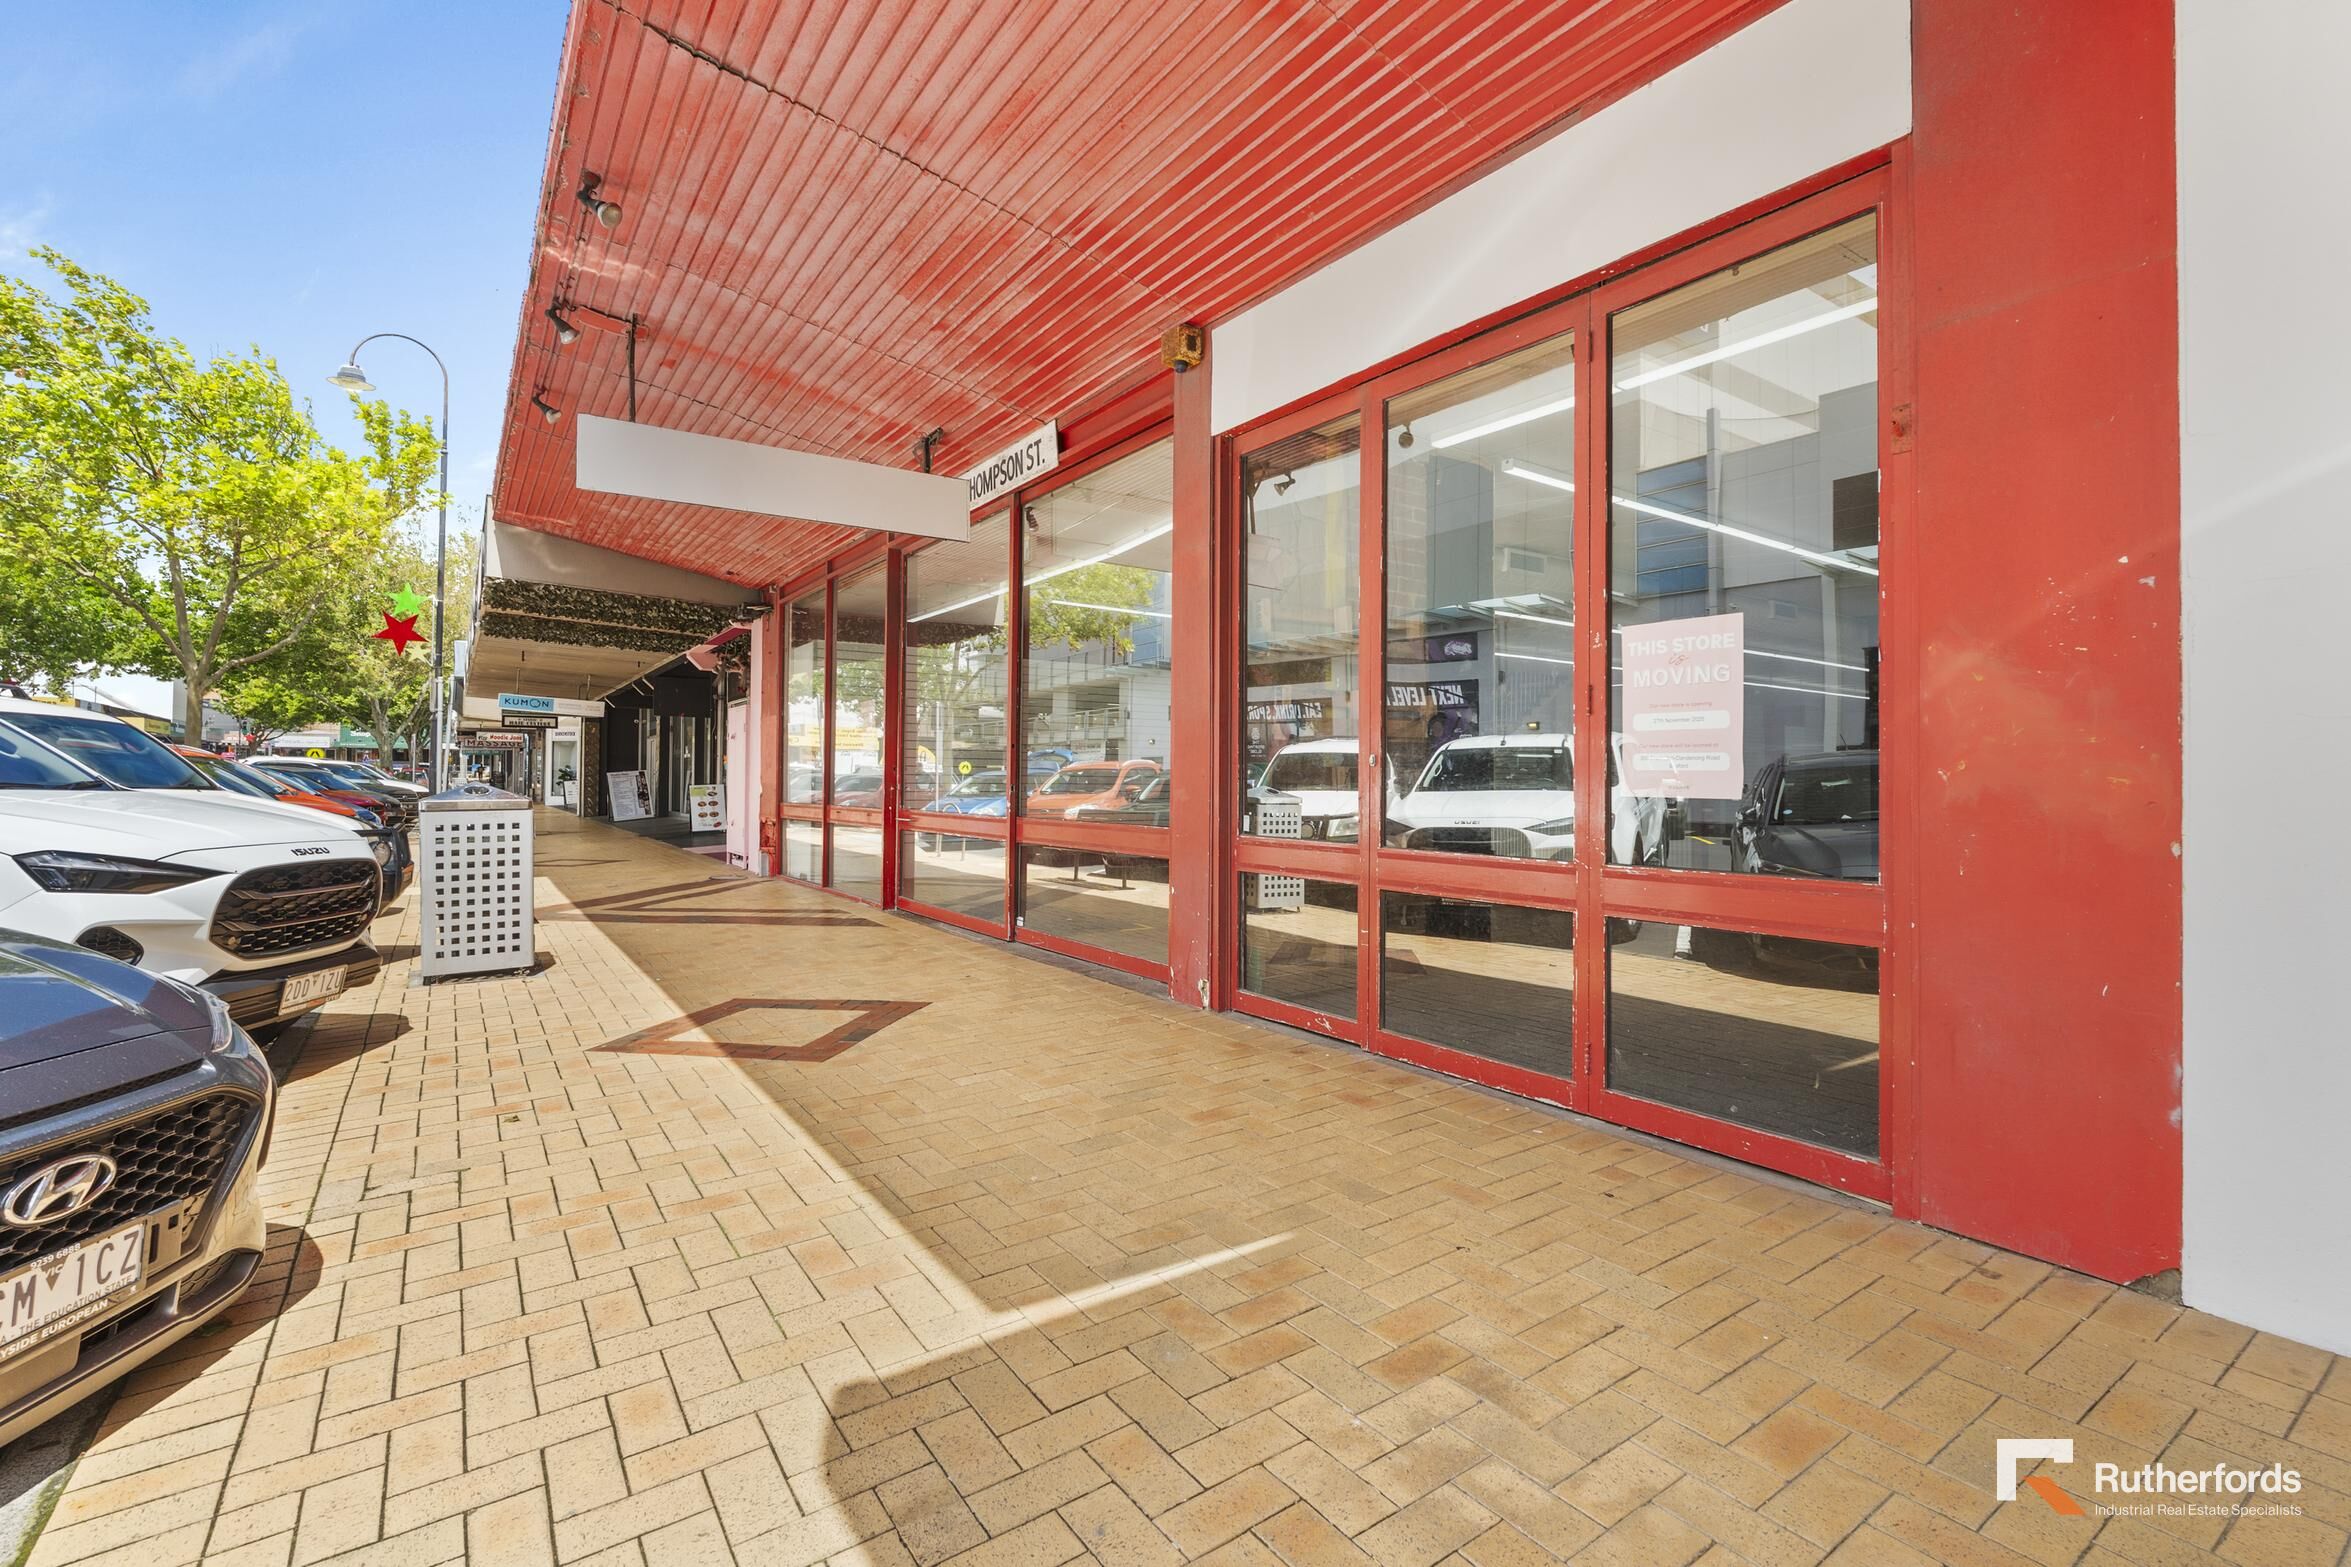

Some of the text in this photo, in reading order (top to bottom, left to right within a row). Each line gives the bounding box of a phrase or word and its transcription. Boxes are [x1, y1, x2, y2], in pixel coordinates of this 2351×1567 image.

[1026, 438, 1046, 471] ST.
[1627, 632, 1737, 657] THIS STORE
[1668, 653, 1689, 666] is
[1632, 664, 1731, 688] MOVING
[504, 697, 550, 709] KUMON
[467, 739, 522, 747] MASSAGE
[290, 847, 331, 857] ISUZU
[77, 1230, 140, 1297] 1CZ
[19, 1274, 133, 1336] THE EDUCATION STATE
[41, 1298, 109, 1339] EUROPEAN
